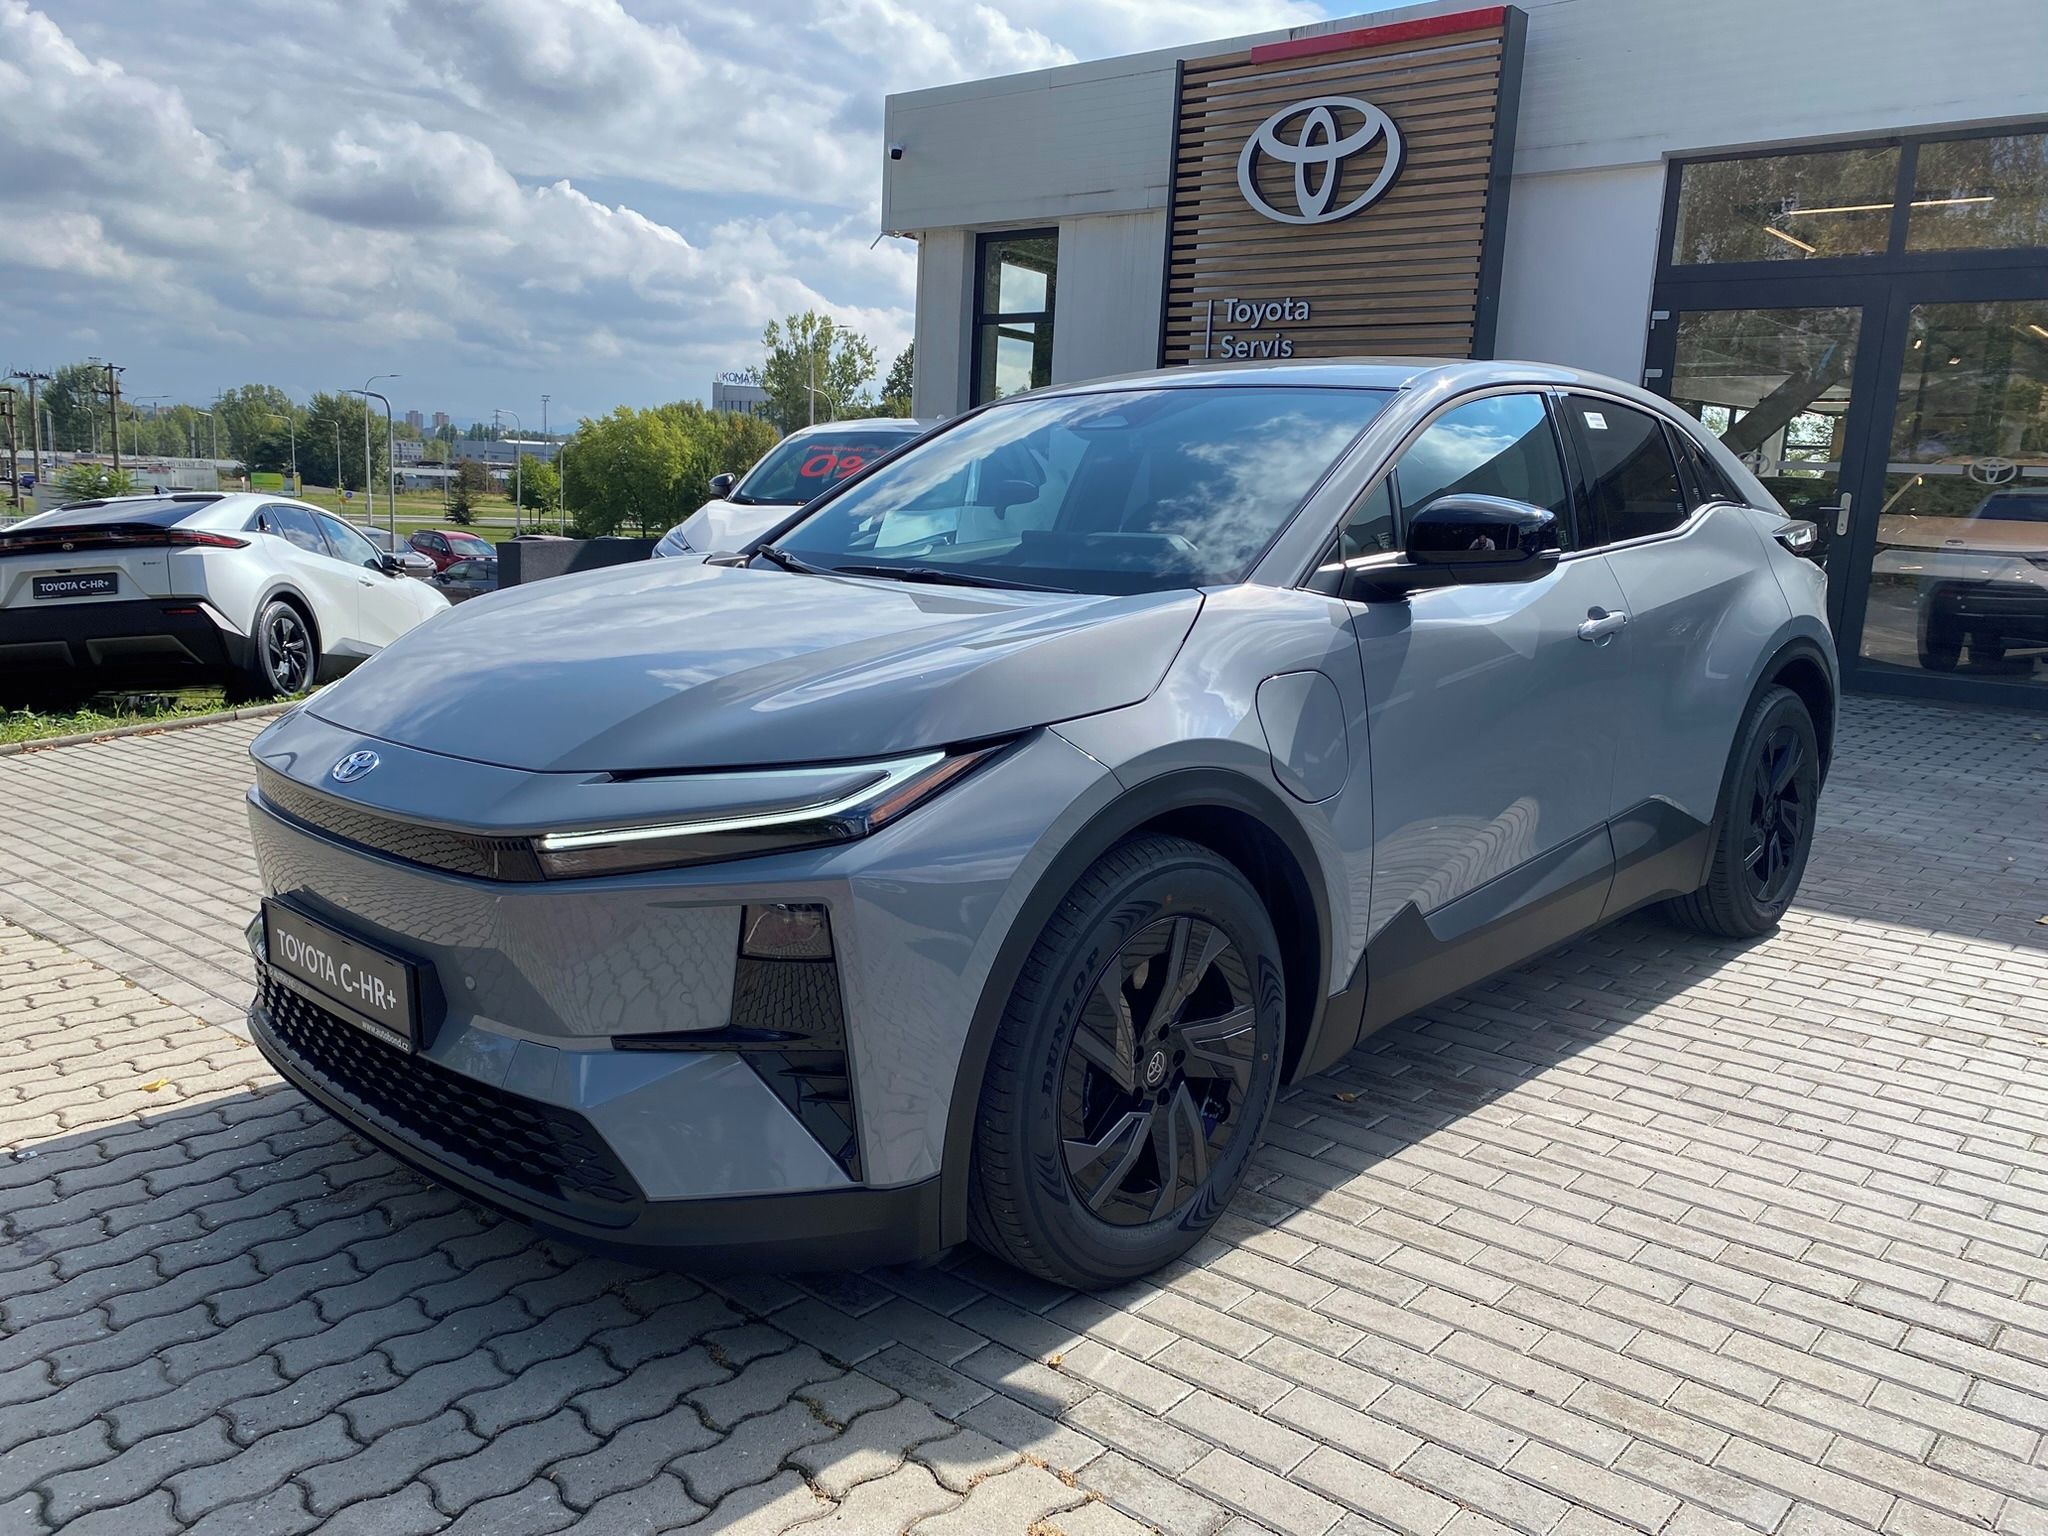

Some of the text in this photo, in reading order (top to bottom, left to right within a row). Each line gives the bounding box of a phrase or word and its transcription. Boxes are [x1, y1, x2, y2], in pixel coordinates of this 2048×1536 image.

[1224, 297, 1310, 328] Toyota
[1220, 333, 1294, 359] Servis
[40, 579, 109, 592] TOYOTA C-HR+
[277, 928, 397, 1011] TOYOTA C-HR+
[1041, 945, 1099, 1097] DUNLOP
